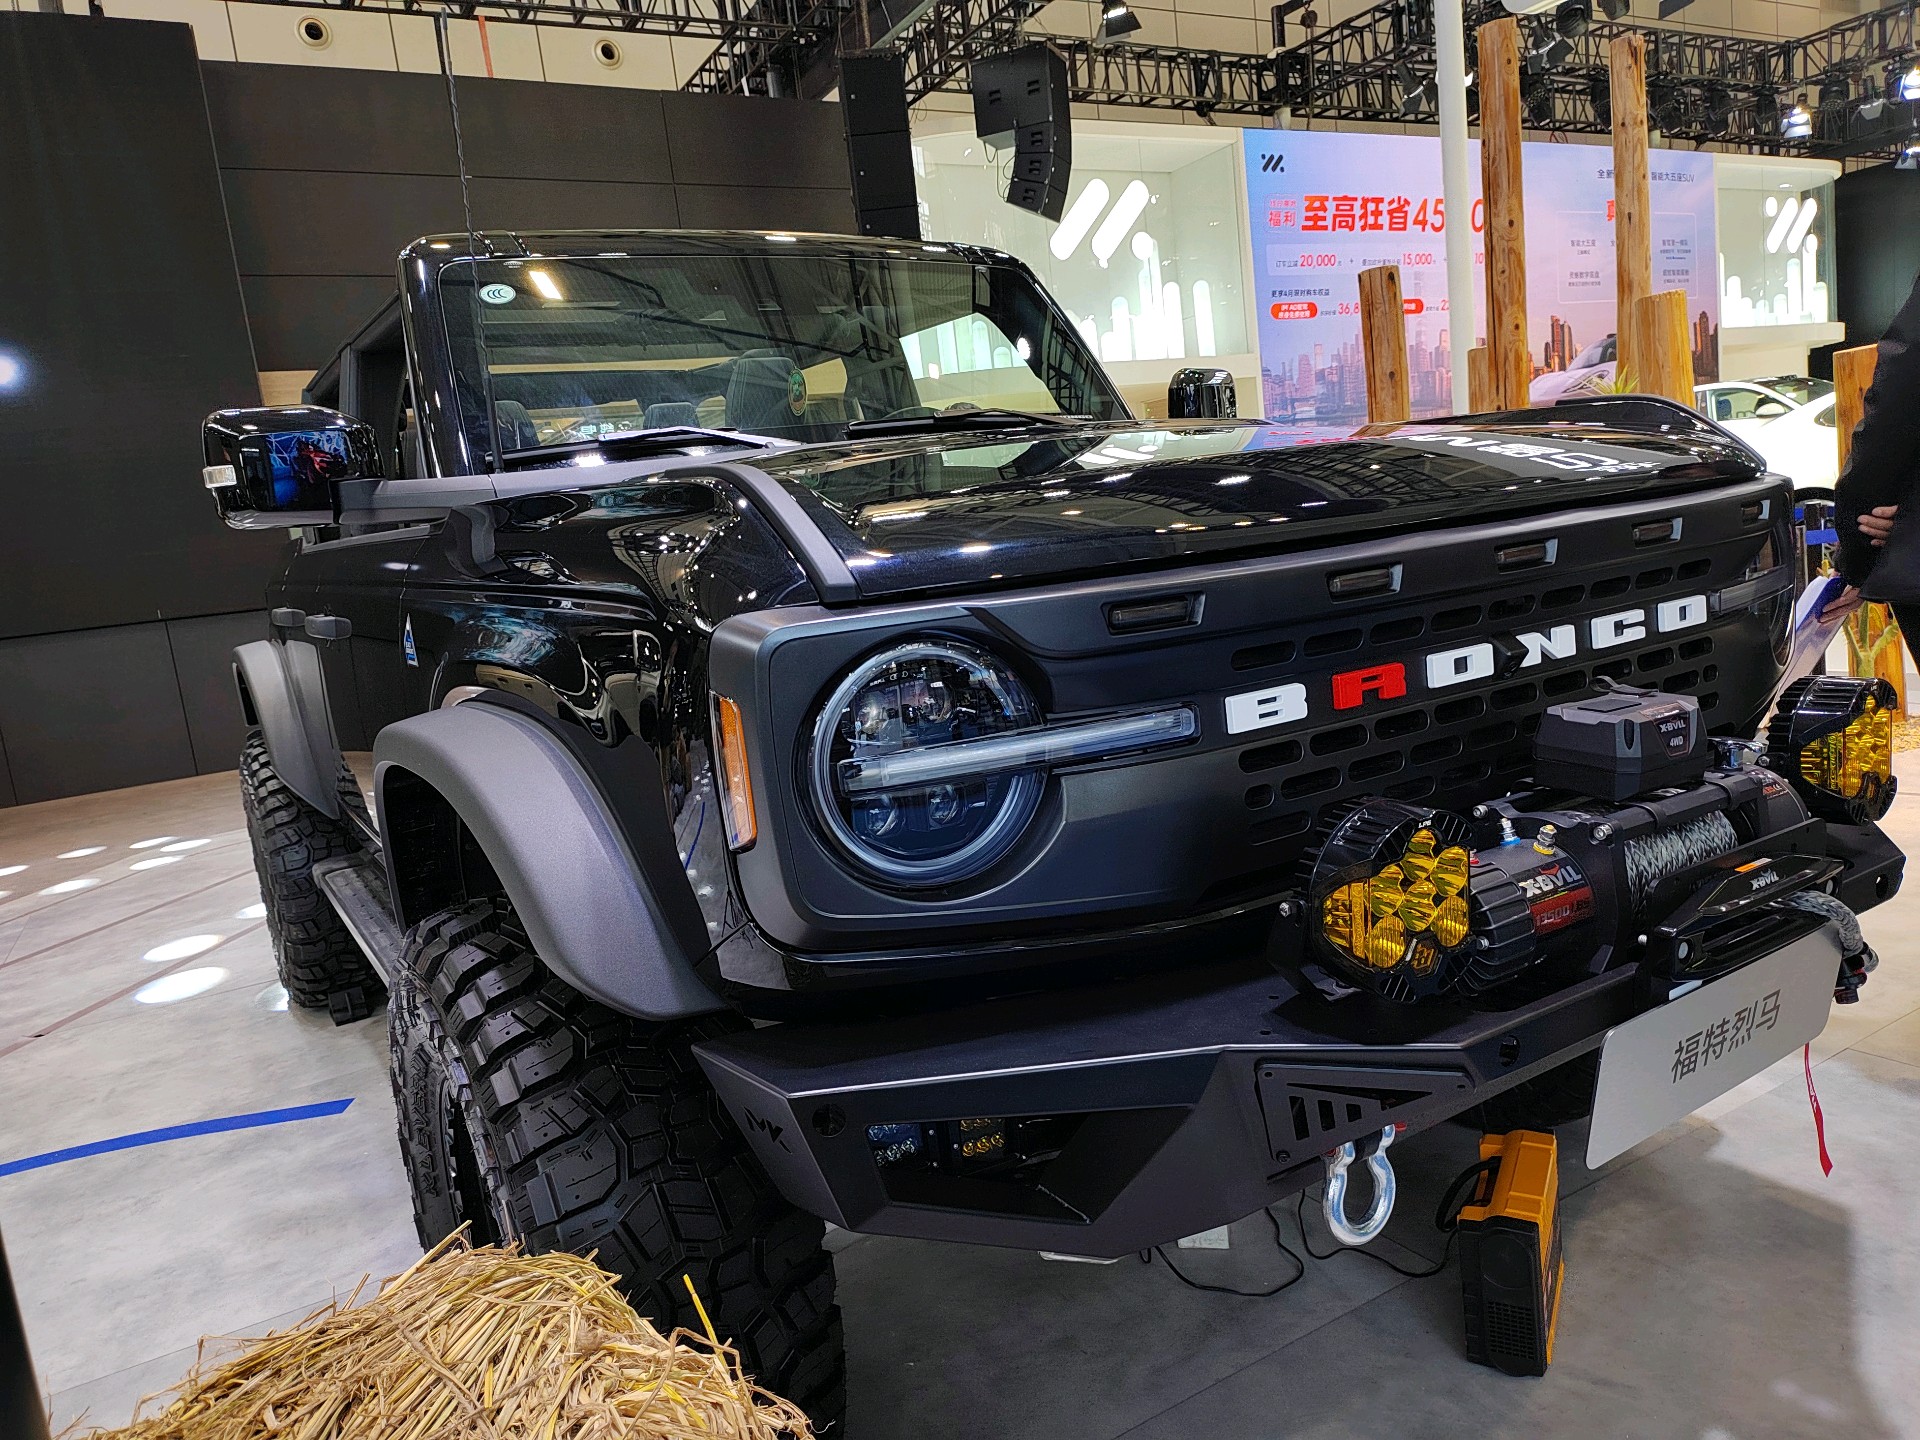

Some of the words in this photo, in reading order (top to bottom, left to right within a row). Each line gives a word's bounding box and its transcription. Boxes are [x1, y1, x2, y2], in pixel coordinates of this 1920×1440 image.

[1269, 210, 1297, 227] 福利
[1300, 254, 1336, 269] 20,000
[1403, 253, 1433, 267] 15,000
[1337, 301, 1360, 316] 36,8
[1224, 594, 1708, 735] BRONCO
[1669, 735, 1684, 747] 4WD
[1671, 988, 1782, 1085] 福特烈马
